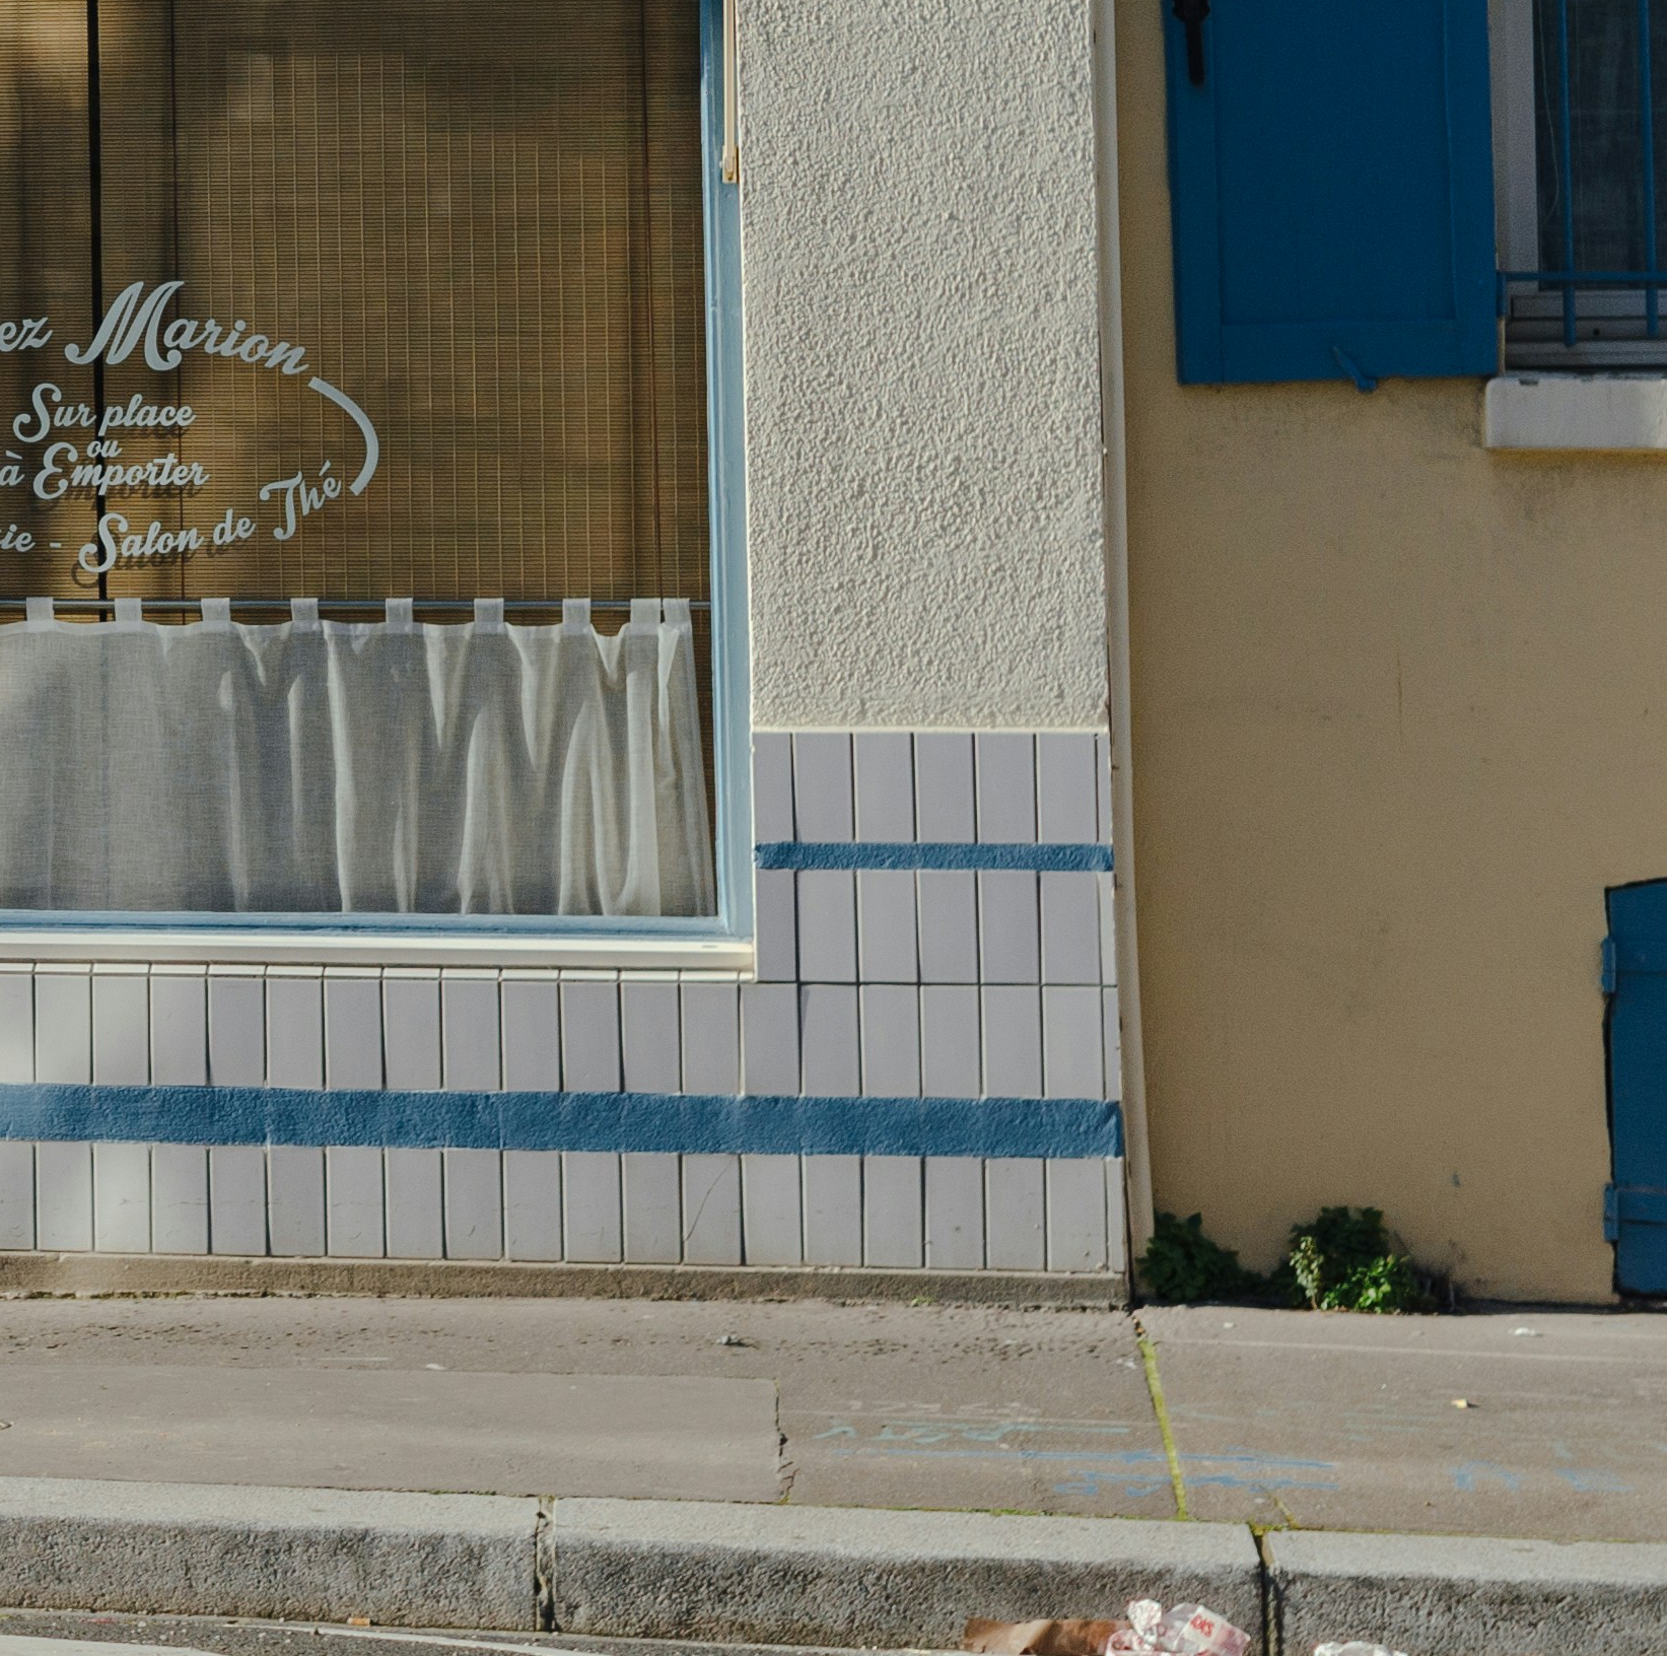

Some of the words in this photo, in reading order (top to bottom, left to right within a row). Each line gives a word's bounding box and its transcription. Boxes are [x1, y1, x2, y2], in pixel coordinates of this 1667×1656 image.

[64, 279, 310, 377] Marion
[12, 381, 96, 444] Sur
[97, 393, 196, 437] place
[33, 441, 209, 502] Emporter
[86, 439, 122, 460] ou
[78, 511, 204, 575] Salon
[213, 507, 256, 541] de
[258, 459, 343, 542] Thé
